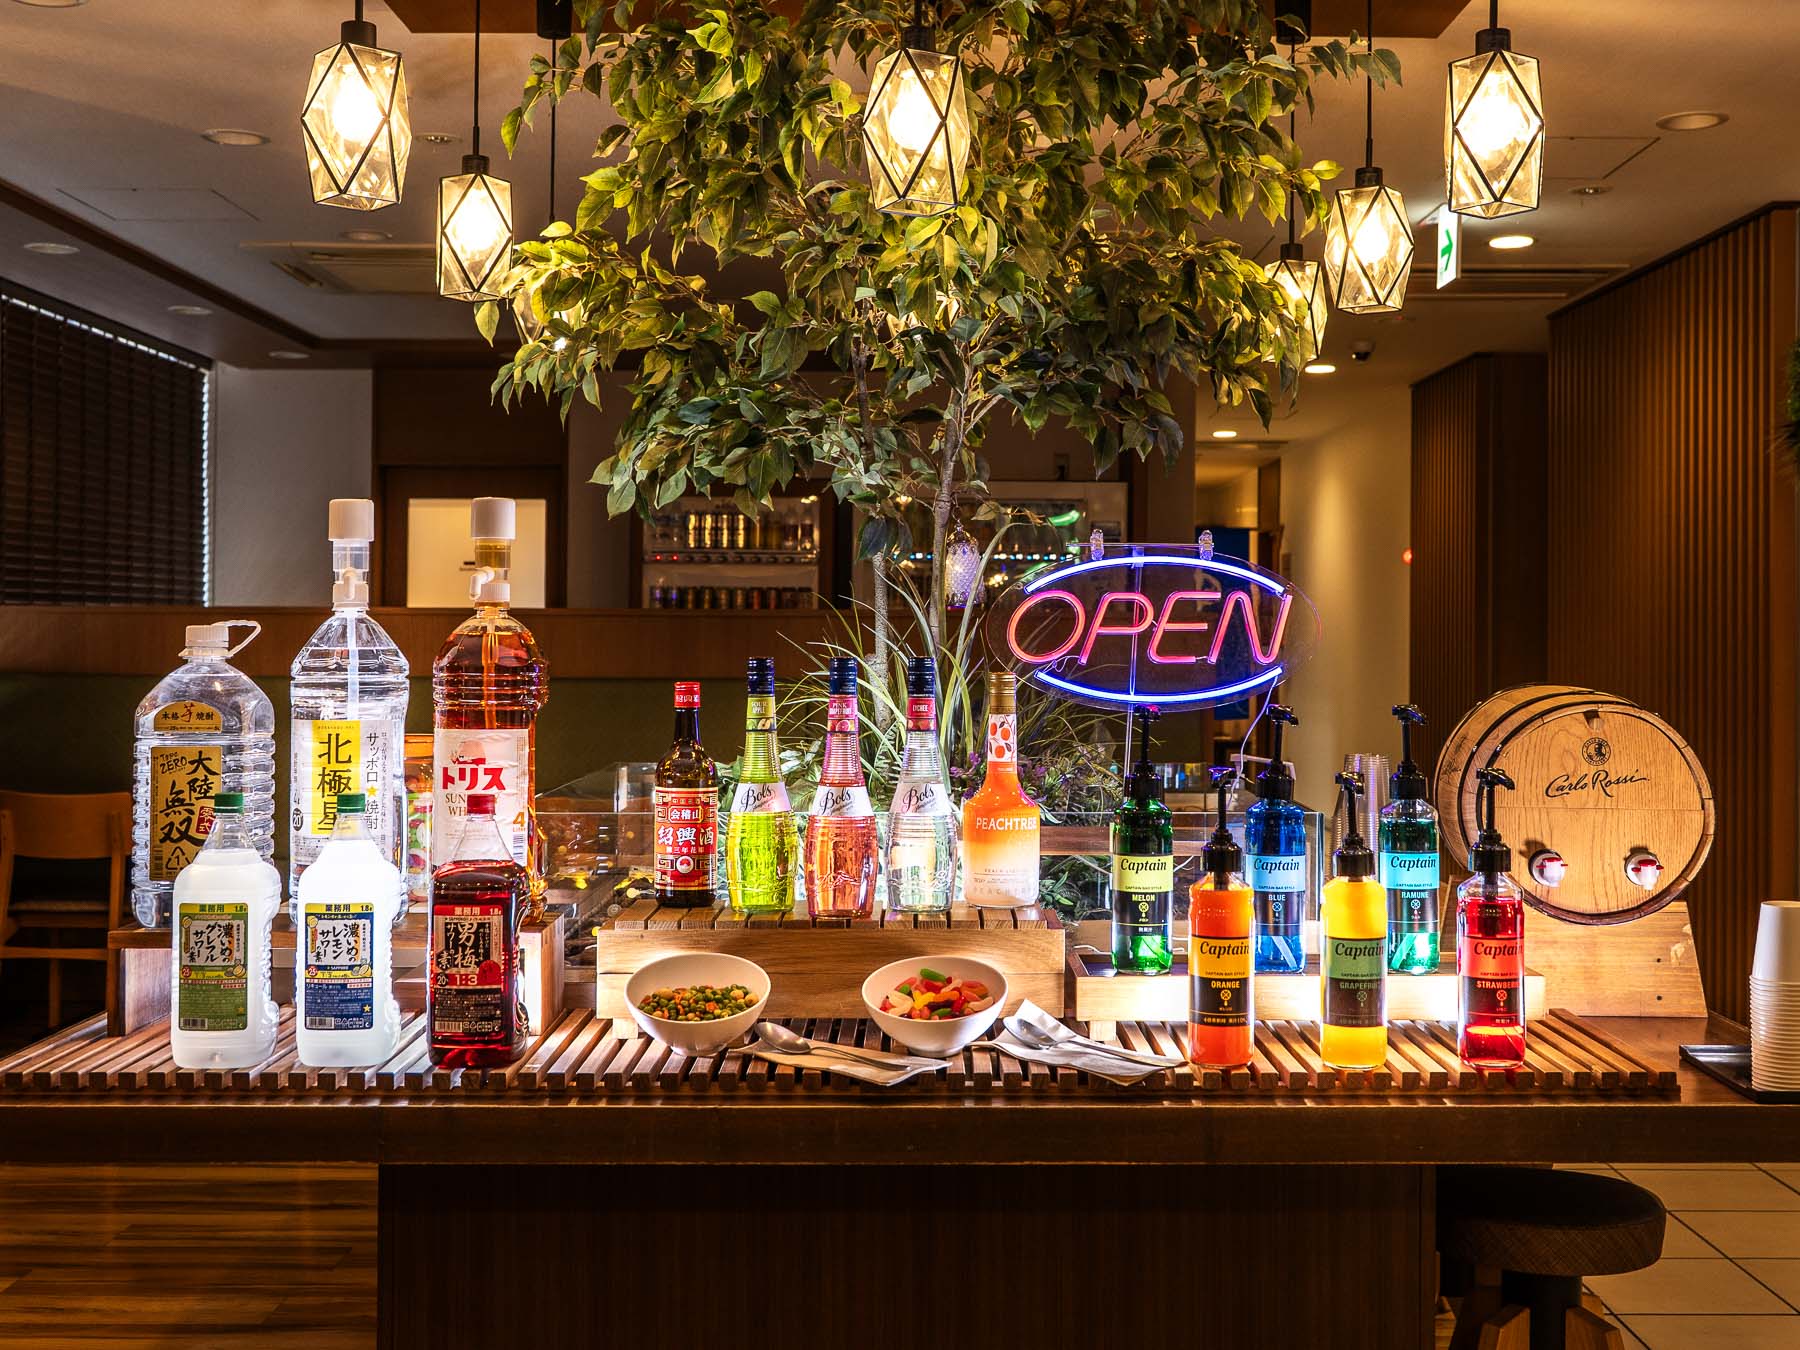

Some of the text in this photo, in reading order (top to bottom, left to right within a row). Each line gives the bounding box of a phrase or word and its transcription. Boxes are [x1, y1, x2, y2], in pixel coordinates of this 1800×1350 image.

[1007, 590, 1293, 664] OPEN
[160, 756, 187, 774] ZERO
[366, 732, 380, 784] サッポロ
[187, 750, 220, 801] 大陸
[442, 767, 506, 791] トリス
[1545, 769, 1650, 798] Carlo Rossi
[741, 783, 775, 812] Bols
[820, 787, 852, 815] Bols
[901, 783, 934, 812] Bols
[159, 779, 207, 847] 無双
[513, 811, 526, 827] 4
[976, 817, 1037, 831] PEACHTREE
[658, 826, 713, 846] 紹興酒
[1121, 859, 1167, 874] Captain
[1254, 858, 1299, 873] Captain
[1391, 856, 1436, 871] Captain
[199, 904, 225, 912] 業務用
[325, 904, 351, 912] 業務用
[1132, 894, 1155, 902] MELON
[454, 907, 480, 915] 業務用
[205, 921, 220, 963] グレフル
[217, 922, 234, 963] 濃いめの
[332, 926, 344, 960] レモン
[343, 922, 360, 962] 濃いめの
[454, 921, 478, 969] 男梅
[1200, 941, 1249, 958] Captain
[1335, 942, 1384, 960] Captain
[455, 974, 477, 985] 1:3
